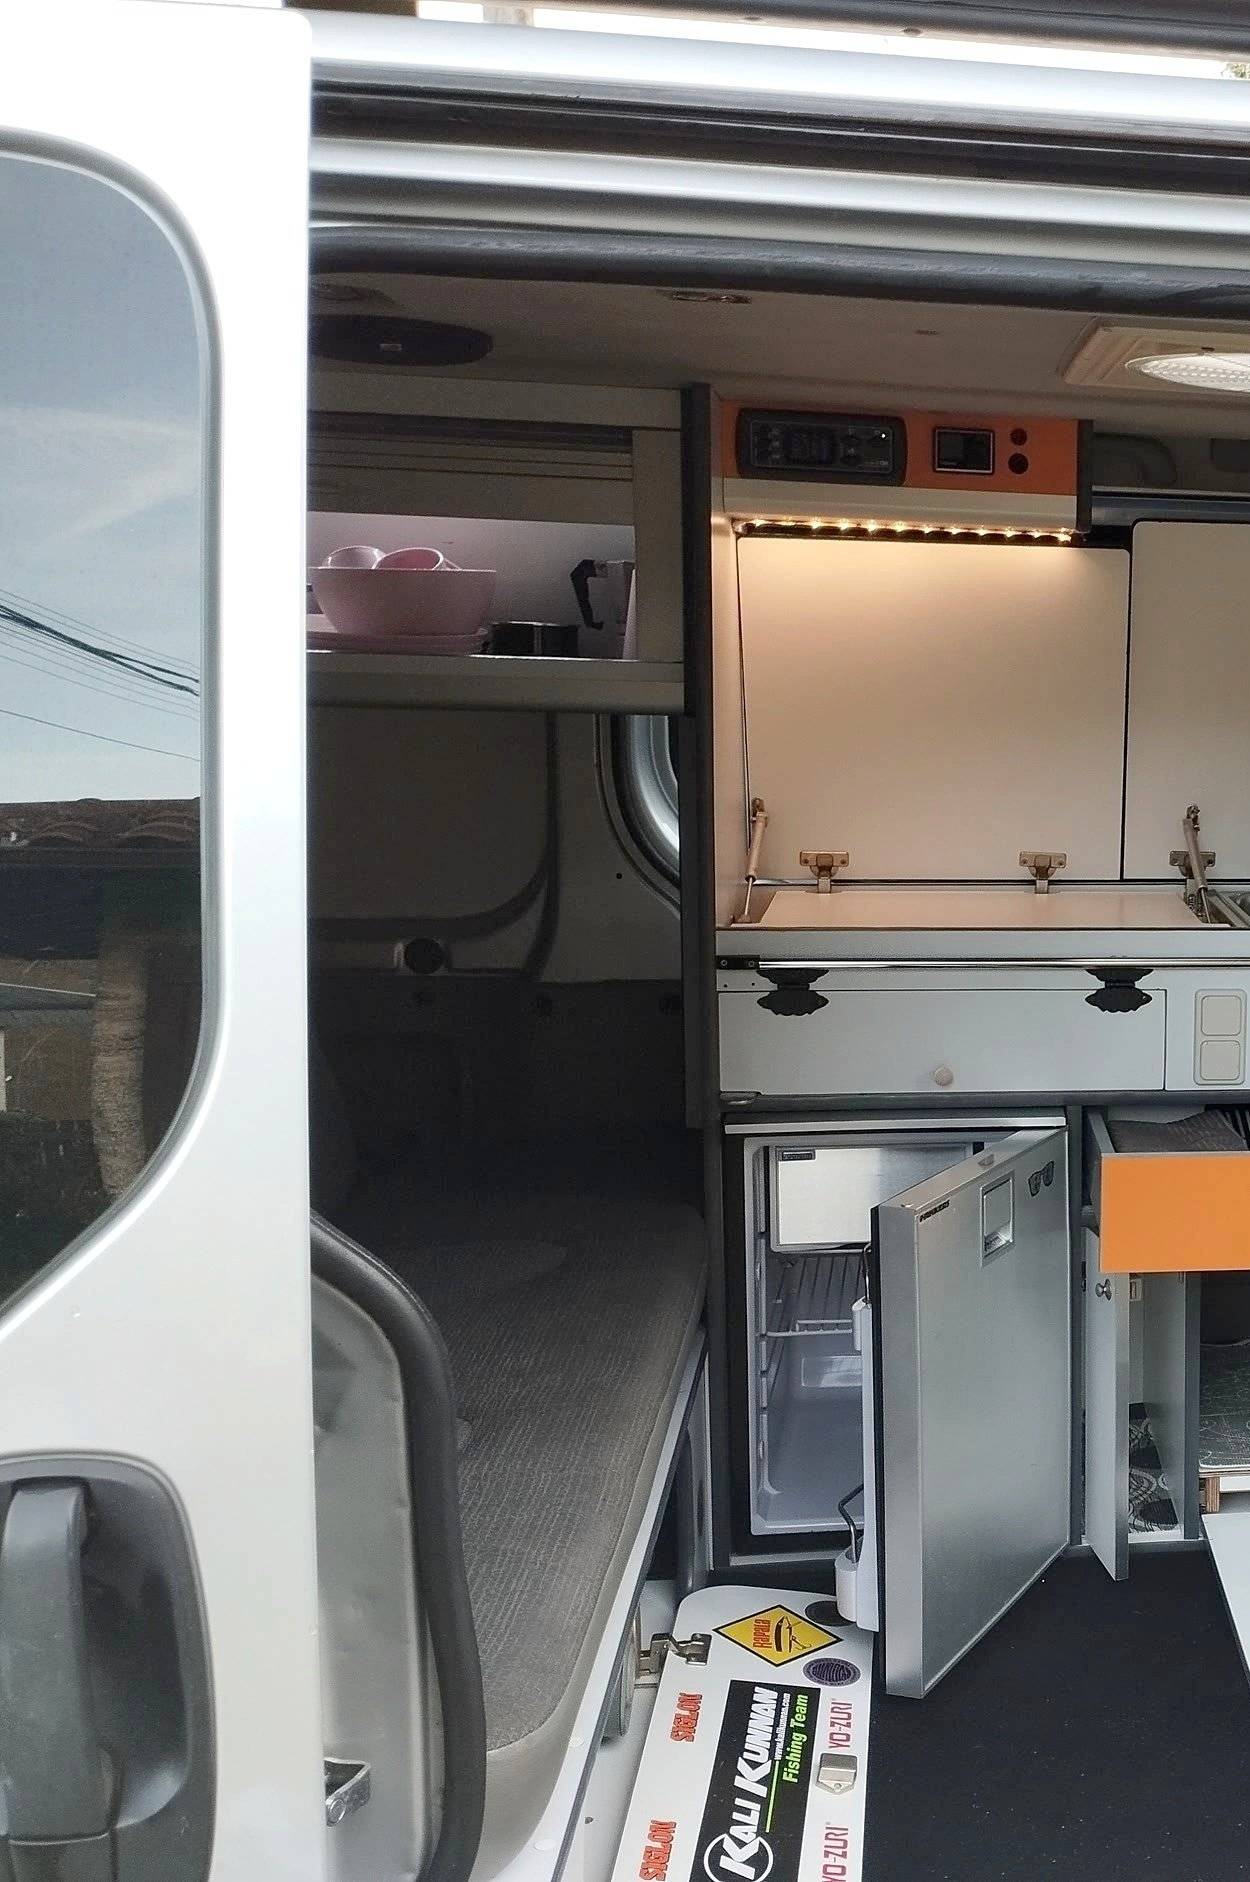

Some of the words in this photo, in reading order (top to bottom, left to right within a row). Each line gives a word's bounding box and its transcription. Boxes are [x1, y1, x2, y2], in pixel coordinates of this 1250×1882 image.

[670, 1692, 702, 1742] SIGLON
[789, 1694, 809, 1728] Team
[733, 1686, 779, 1798] KUNNAN
[782, 1732, 808, 1783] Fishing
[639, 1820, 677, 1881] SIGLON
[719, 1797, 762, 1881] KALI
